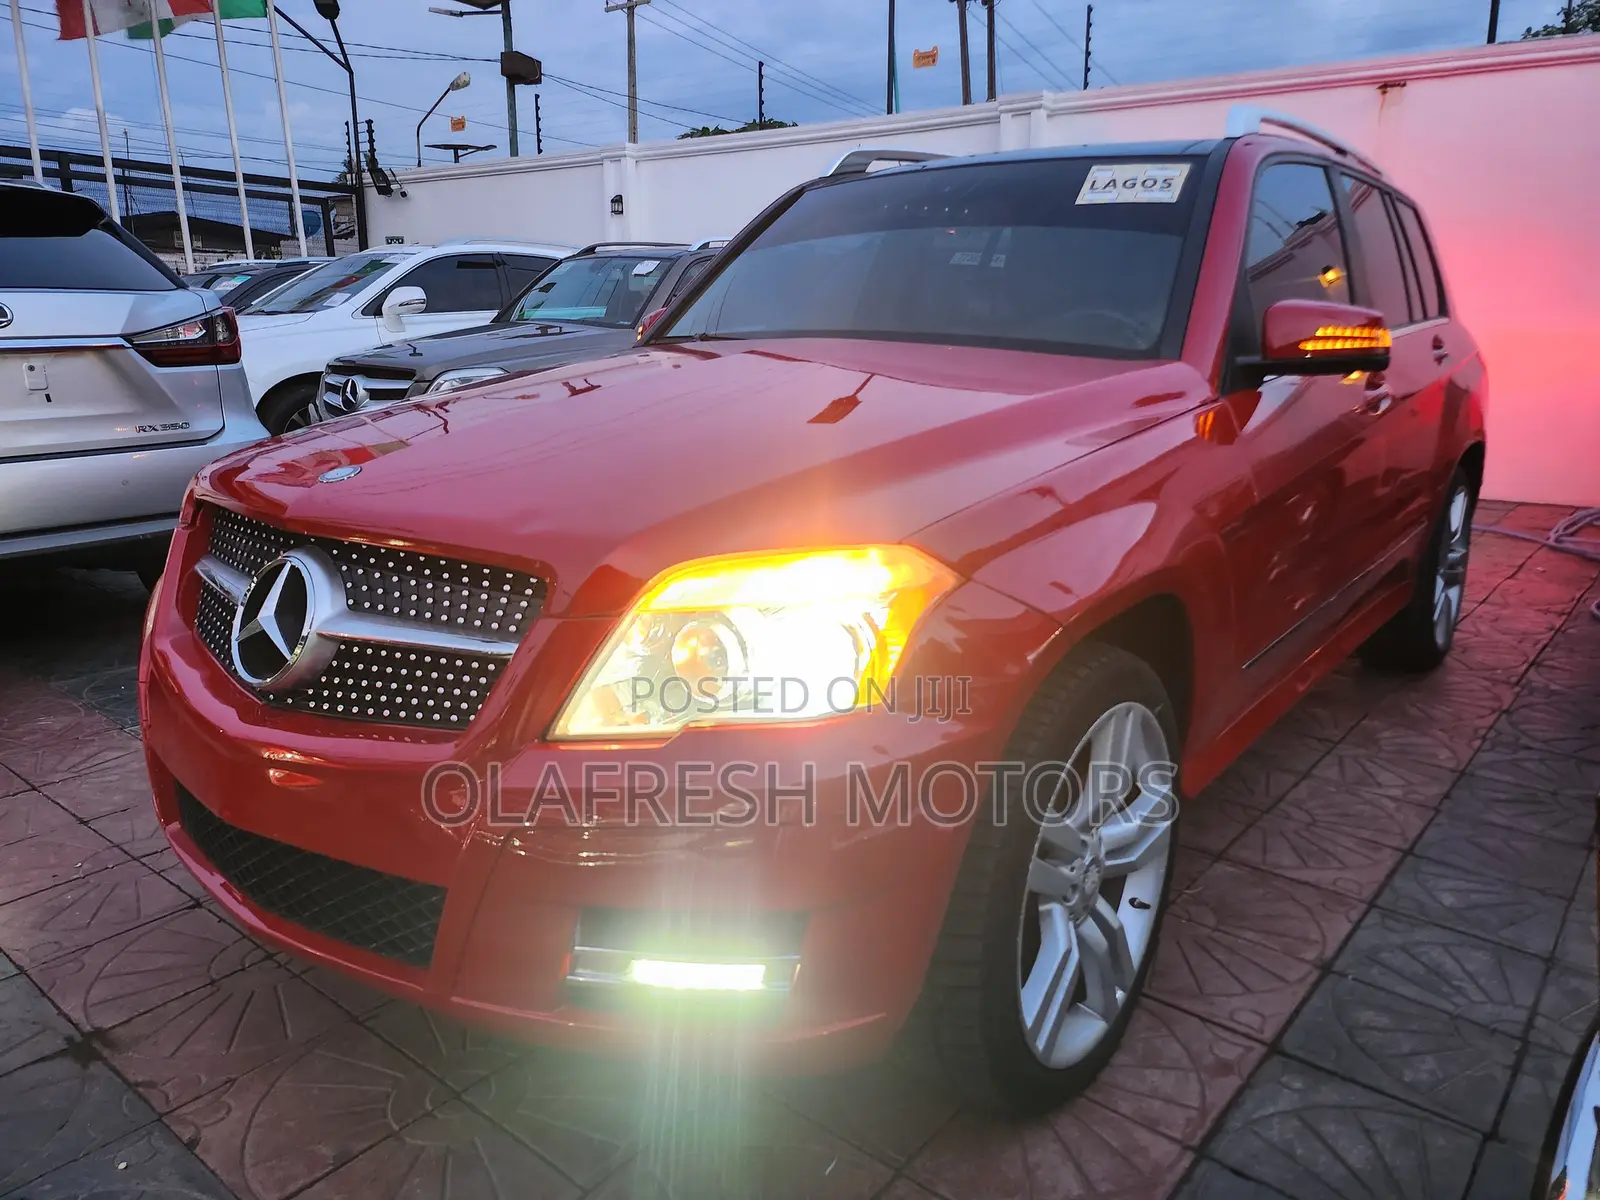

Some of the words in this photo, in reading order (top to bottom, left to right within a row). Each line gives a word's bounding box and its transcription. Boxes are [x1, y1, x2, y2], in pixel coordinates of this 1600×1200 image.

[1089, 178, 1174, 190] LAGOS
[135, 424, 160, 433] RX
[160, 421, 190, 431] 350
